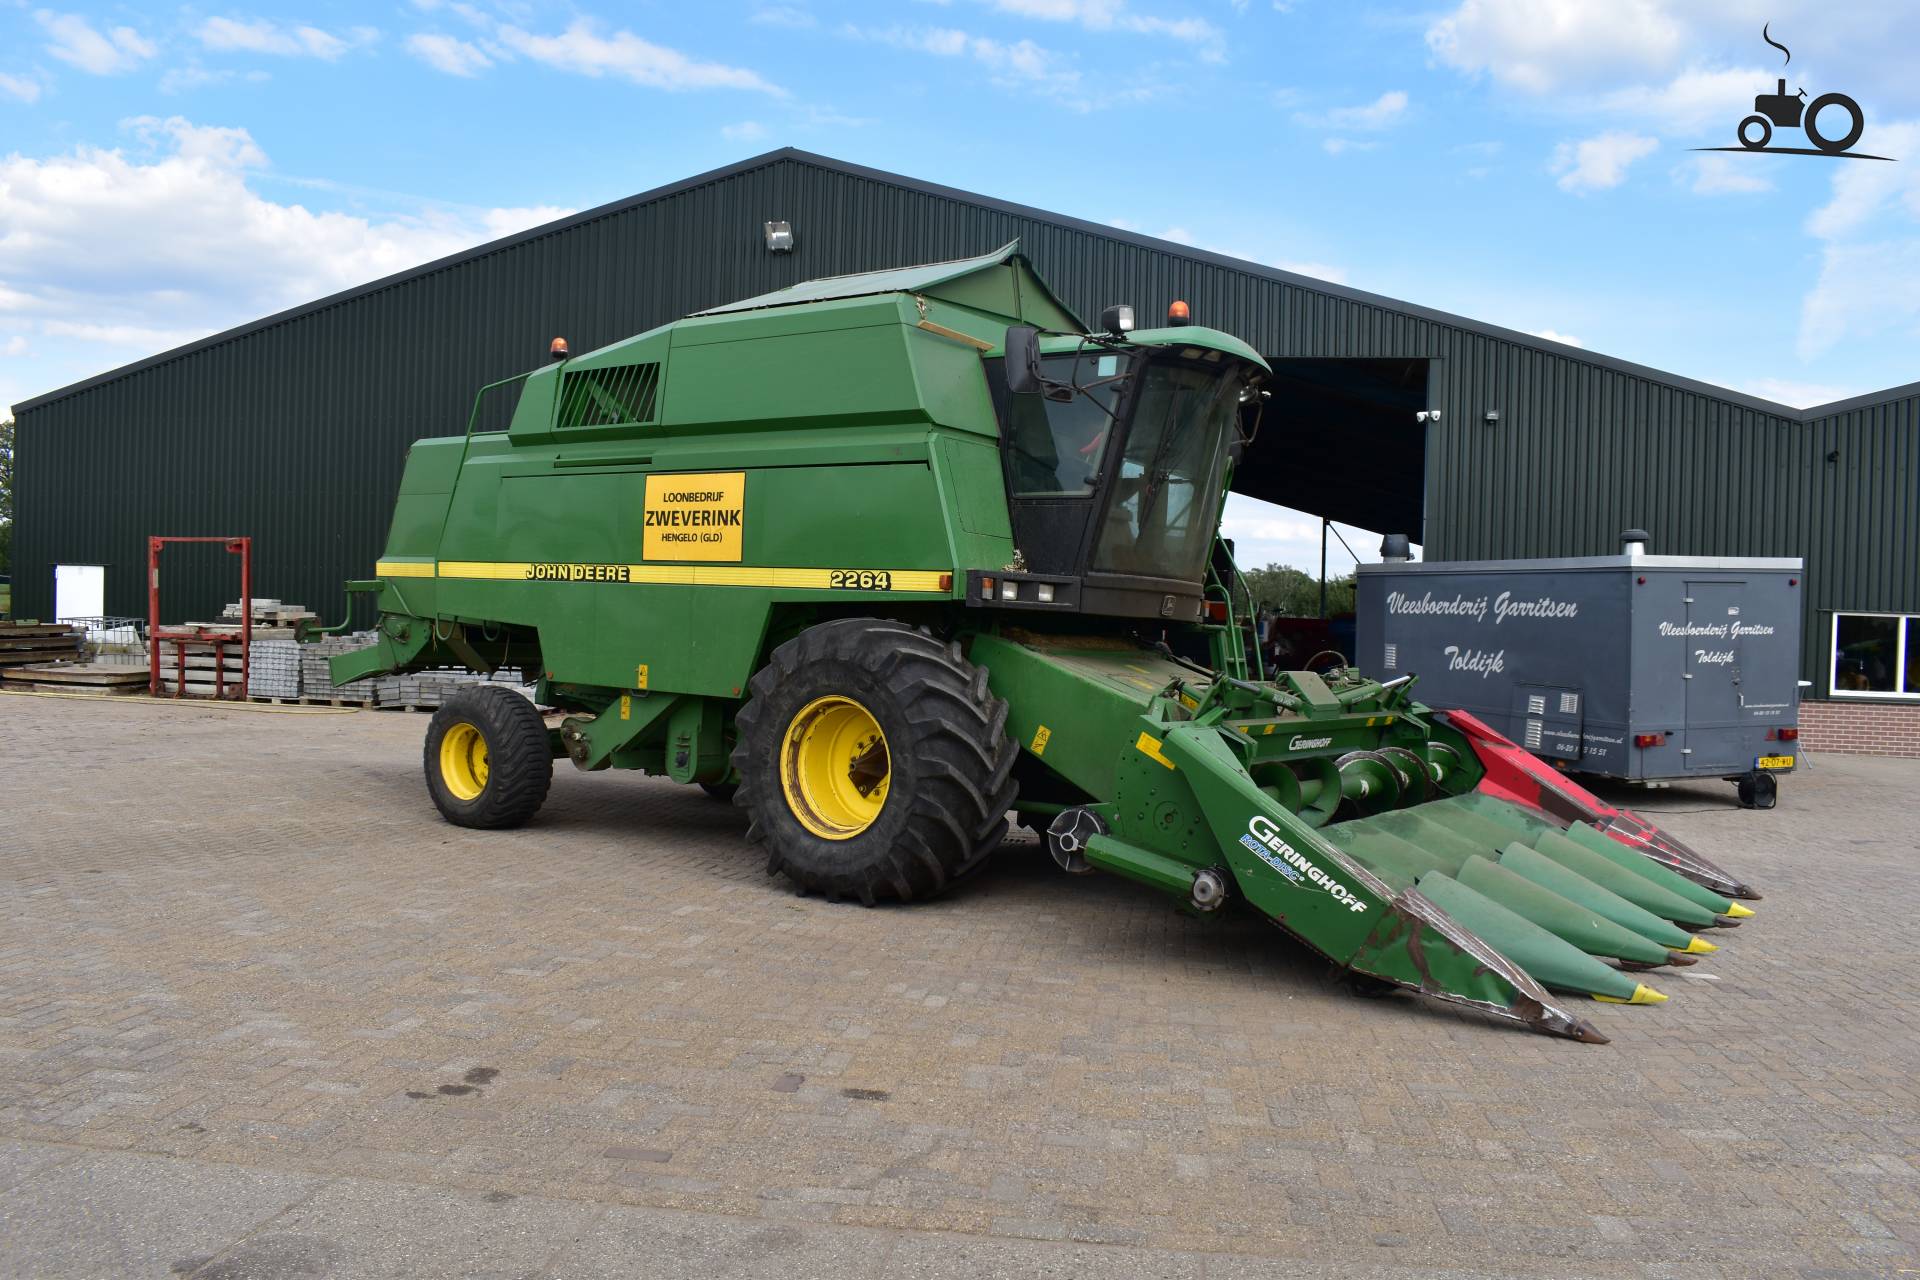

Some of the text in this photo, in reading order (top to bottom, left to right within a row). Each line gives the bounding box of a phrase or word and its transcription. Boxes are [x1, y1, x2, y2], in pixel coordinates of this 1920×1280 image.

[663, 491, 724, 503] LOONBEDRIJF
[645, 509, 741, 527] ZWEVERINK
[661, 532, 723, 543] HENGELO (GLD)
[526, 564, 630, 582] JOHN DEERE
[831, 570, 891, 590] 2264
[1387, 591, 1578, 624] Vleesboerderij Garritsen
[1659, 620, 1774, 640] Vleesboerderij Garritsen
[1444, 645, 1504, 679] Toldijk
[1695, 650, 1735, 666] Toldijk
[1288, 735, 1332, 751] GERINGHOFF
[1248, 815, 1368, 913] GERINGHOFF
